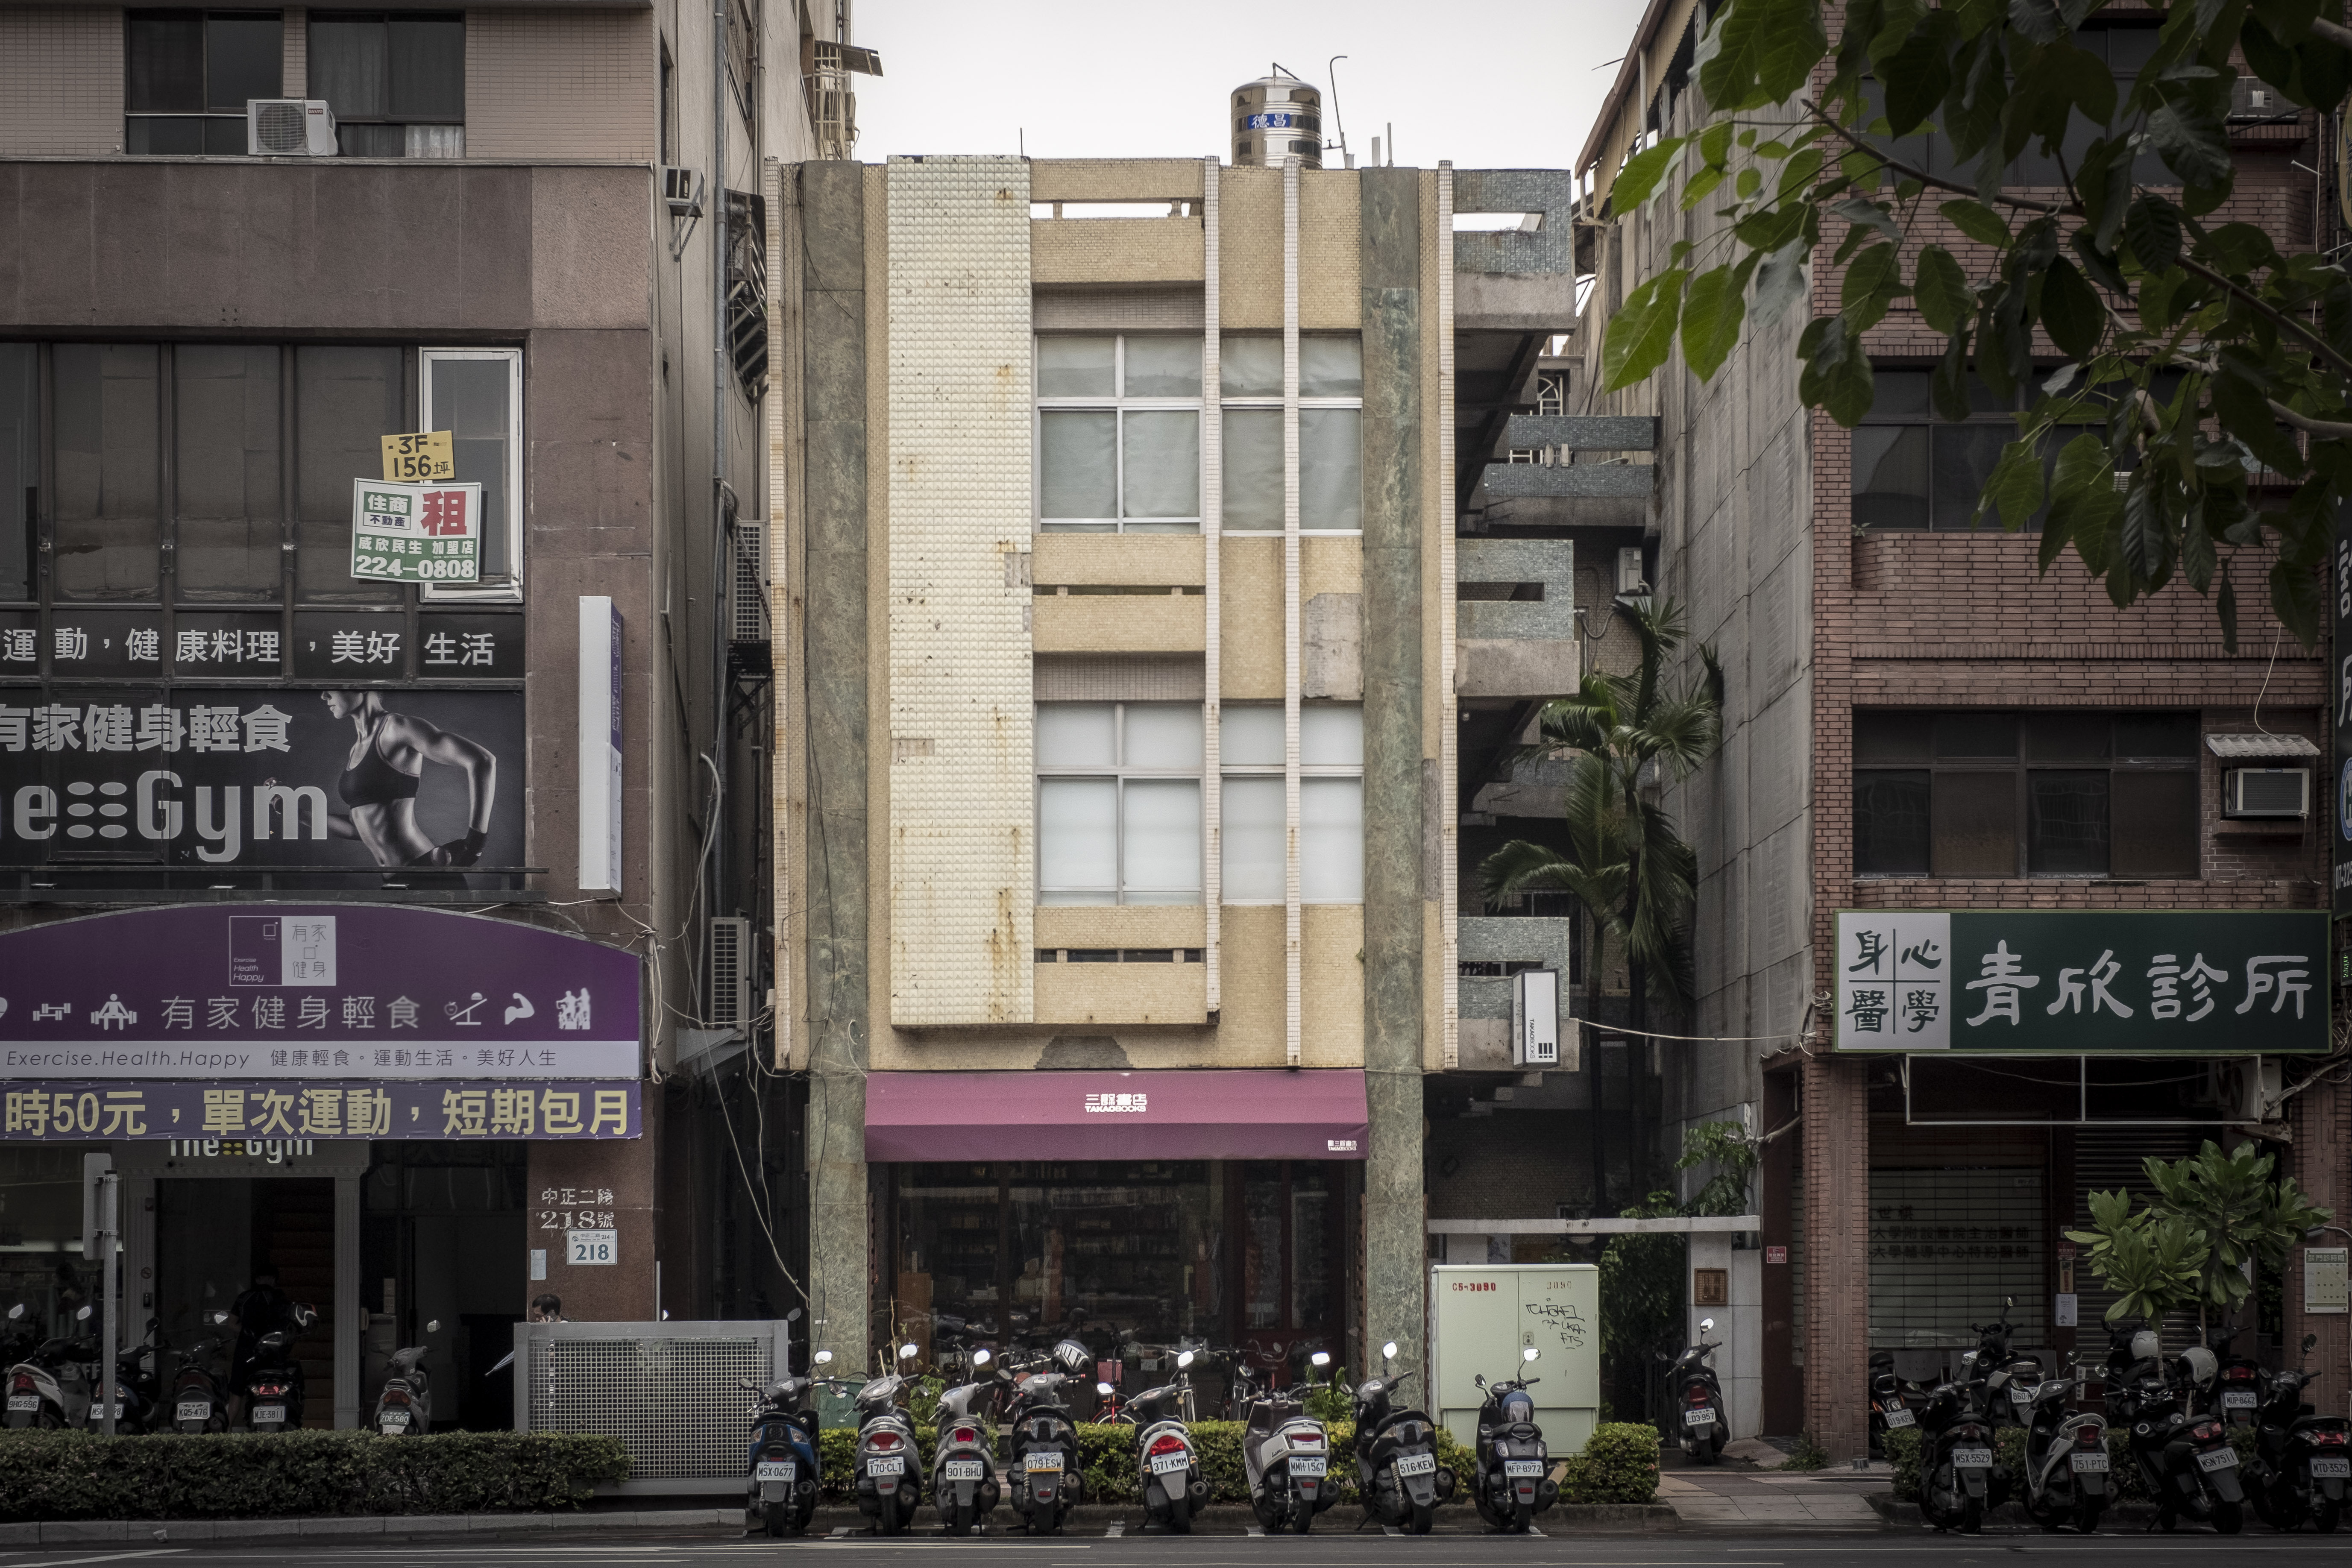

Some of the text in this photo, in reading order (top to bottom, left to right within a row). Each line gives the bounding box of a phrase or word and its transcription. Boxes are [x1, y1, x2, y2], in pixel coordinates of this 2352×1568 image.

[393, 455, 451, 478] 156坪
[368, 494, 408, 513] 住商
[420, 490, 467, 536] 租
[370, 514, 405, 527] 不動產
[358, 536, 474, 555] 威欣民生 加盟店
[356, 555, 475, 578] 224-0808
[0, 704, 292, 752] 有家健身輕食
[292, 924, 326, 942] 有家
[233, 973, 264, 982] Happy
[292, 961, 326, 978] 健身
[1965, 940, 2312, 1026] 青欣診所
[161, 995, 420, 1029] 有家健身輕食
[542, 1188, 614, 1205] 中正二路
[541, 1210, 614, 1229] 218號
[575, 1244, 609, 1260] 218
